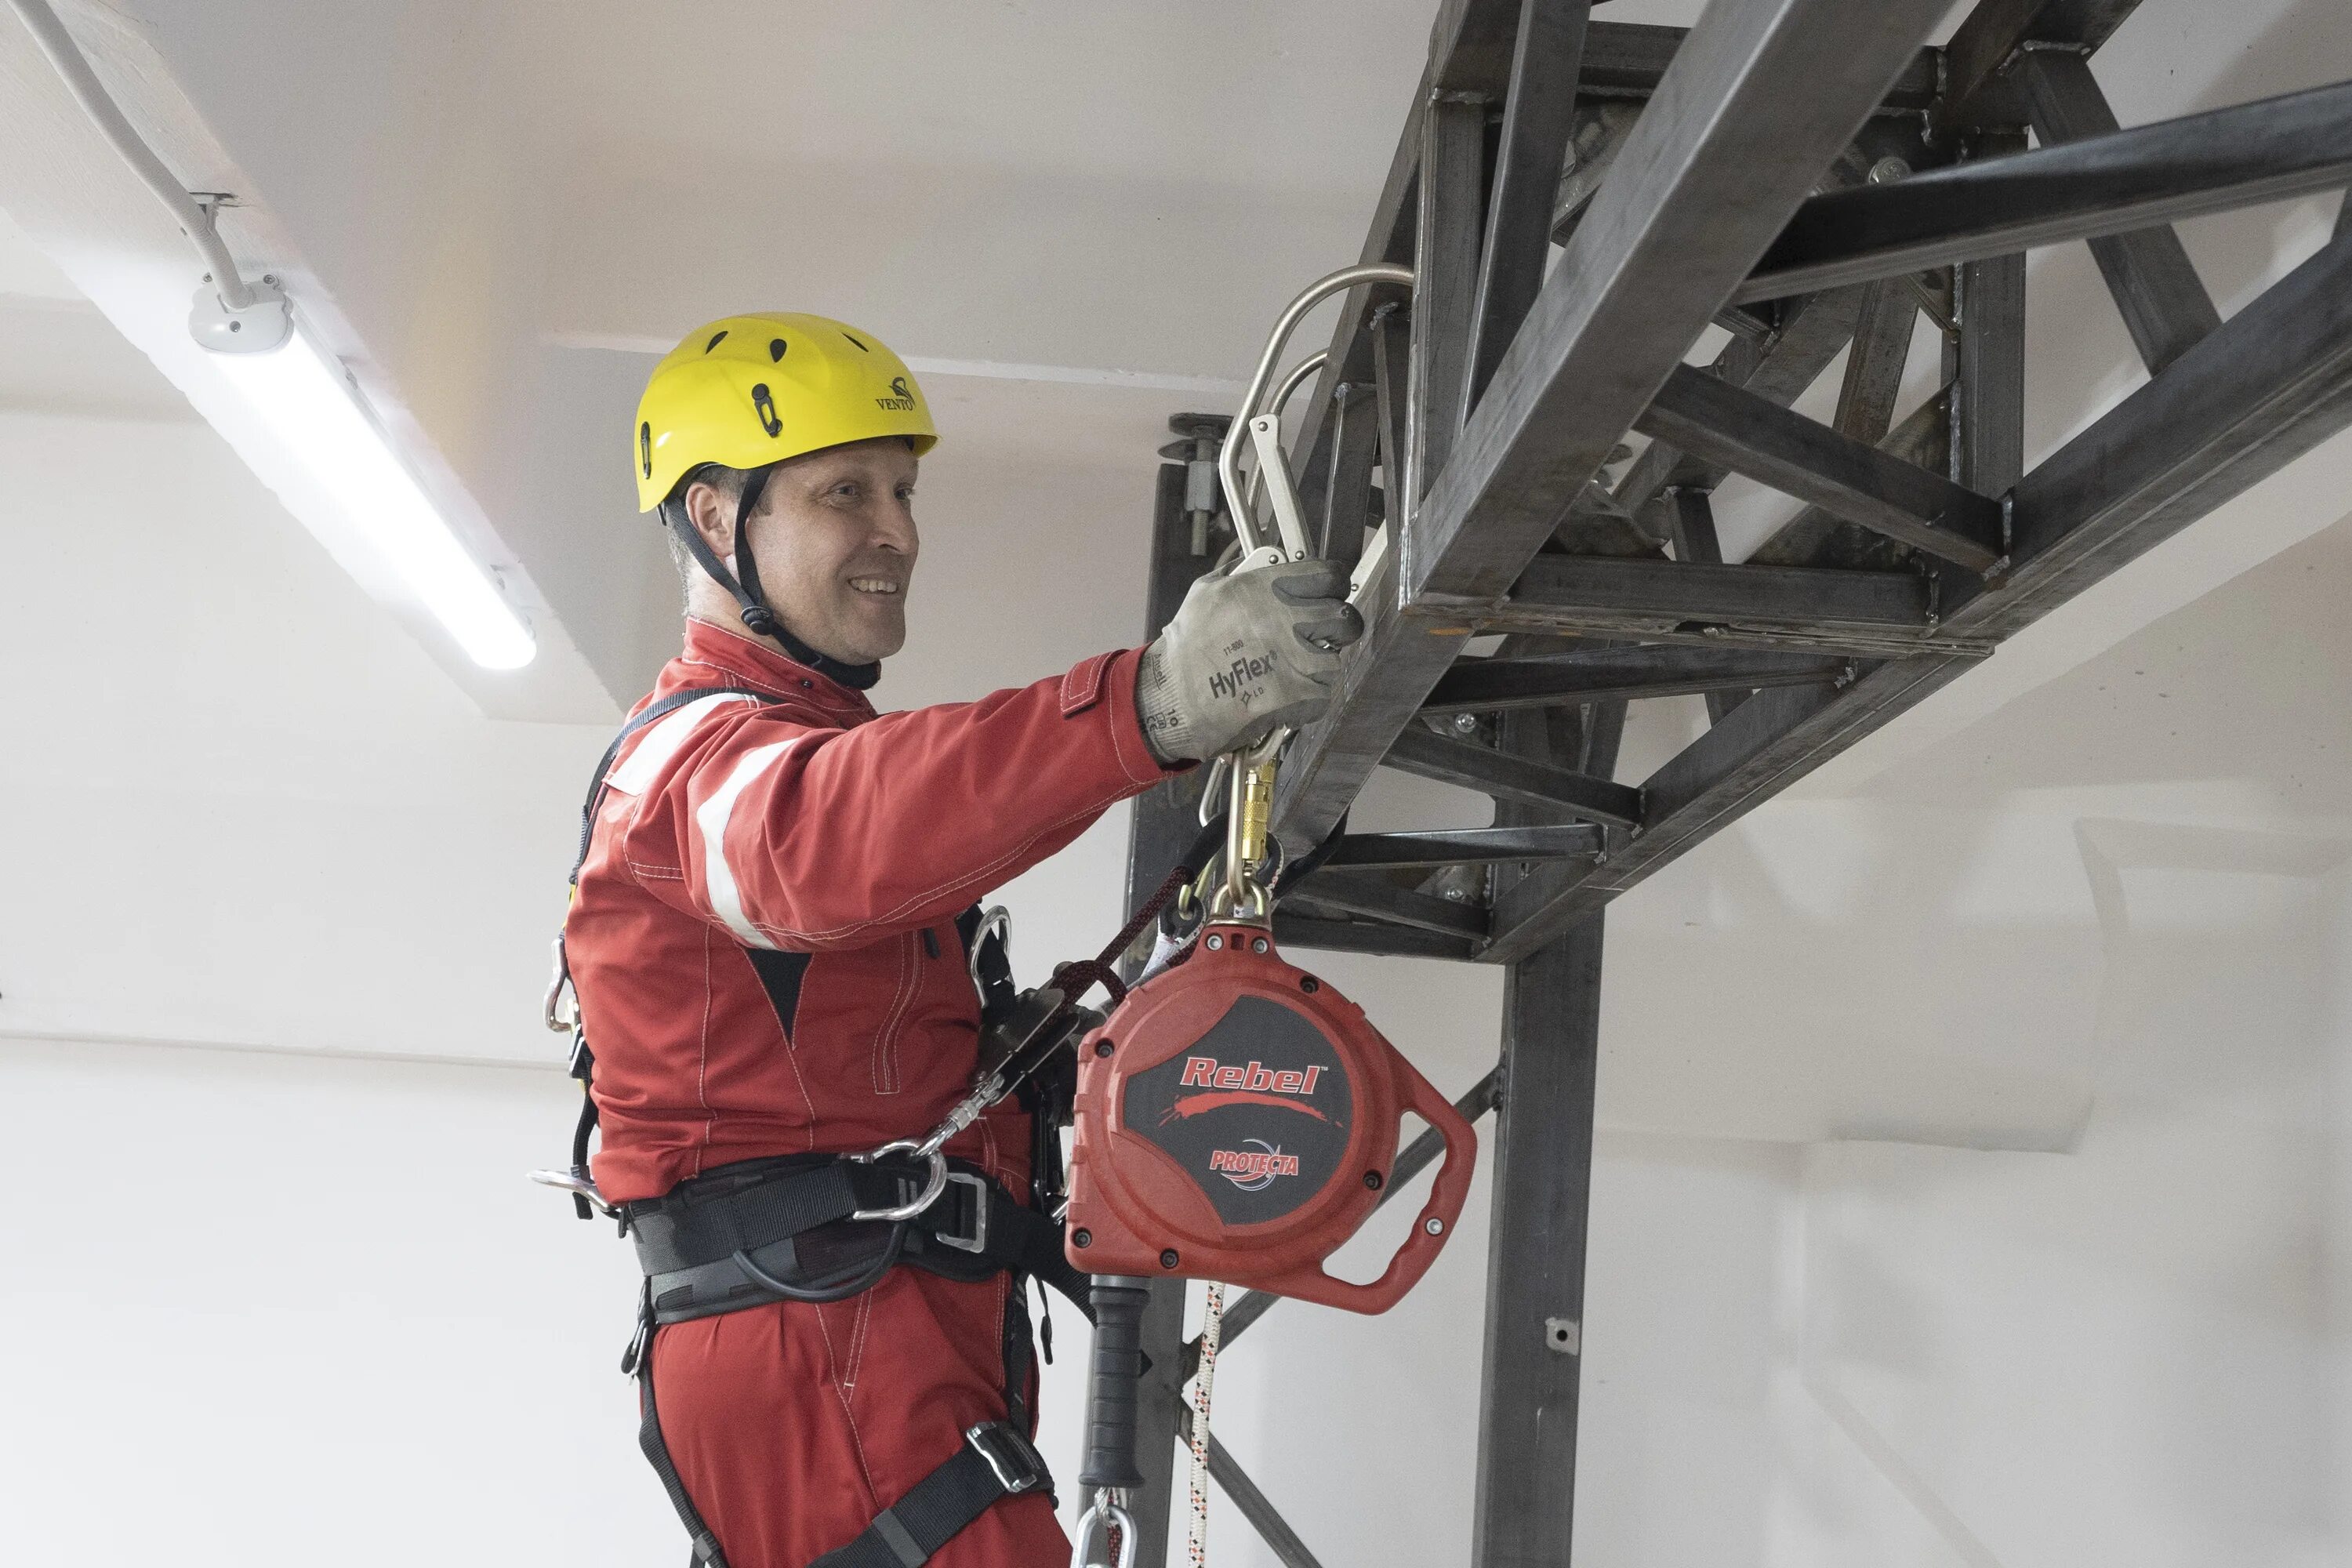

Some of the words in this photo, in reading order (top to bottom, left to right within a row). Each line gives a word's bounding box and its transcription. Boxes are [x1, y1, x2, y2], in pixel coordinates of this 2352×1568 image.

[876, 398, 913, 411] VENTO
[1167, 708, 1178, 727] 10
[1210, 1150, 1298, 1176] PROTECTA
